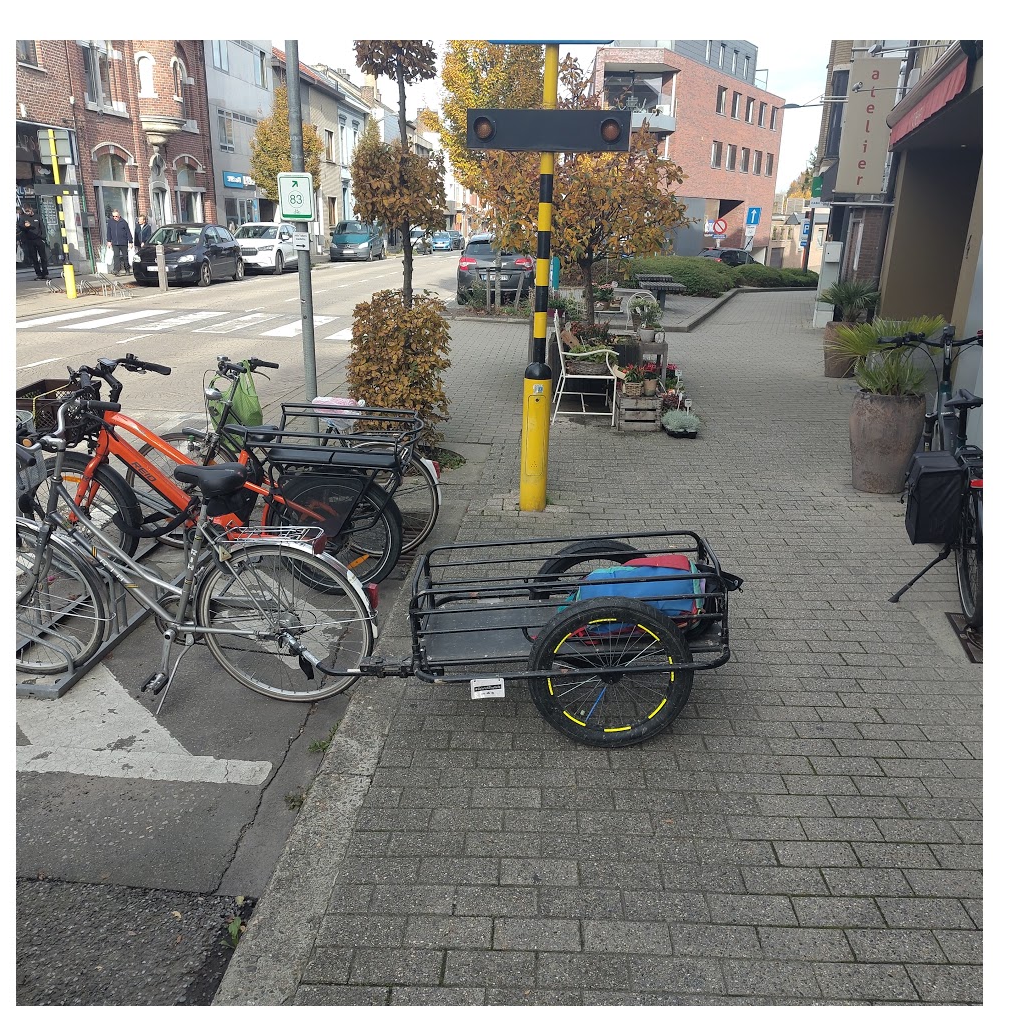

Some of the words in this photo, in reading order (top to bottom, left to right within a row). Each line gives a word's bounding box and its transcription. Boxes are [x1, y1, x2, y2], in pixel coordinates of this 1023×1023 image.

[856, 69, 880, 186] atelier
[289, 194, 303, 205] 83
[131, 461, 157, 482] REID
